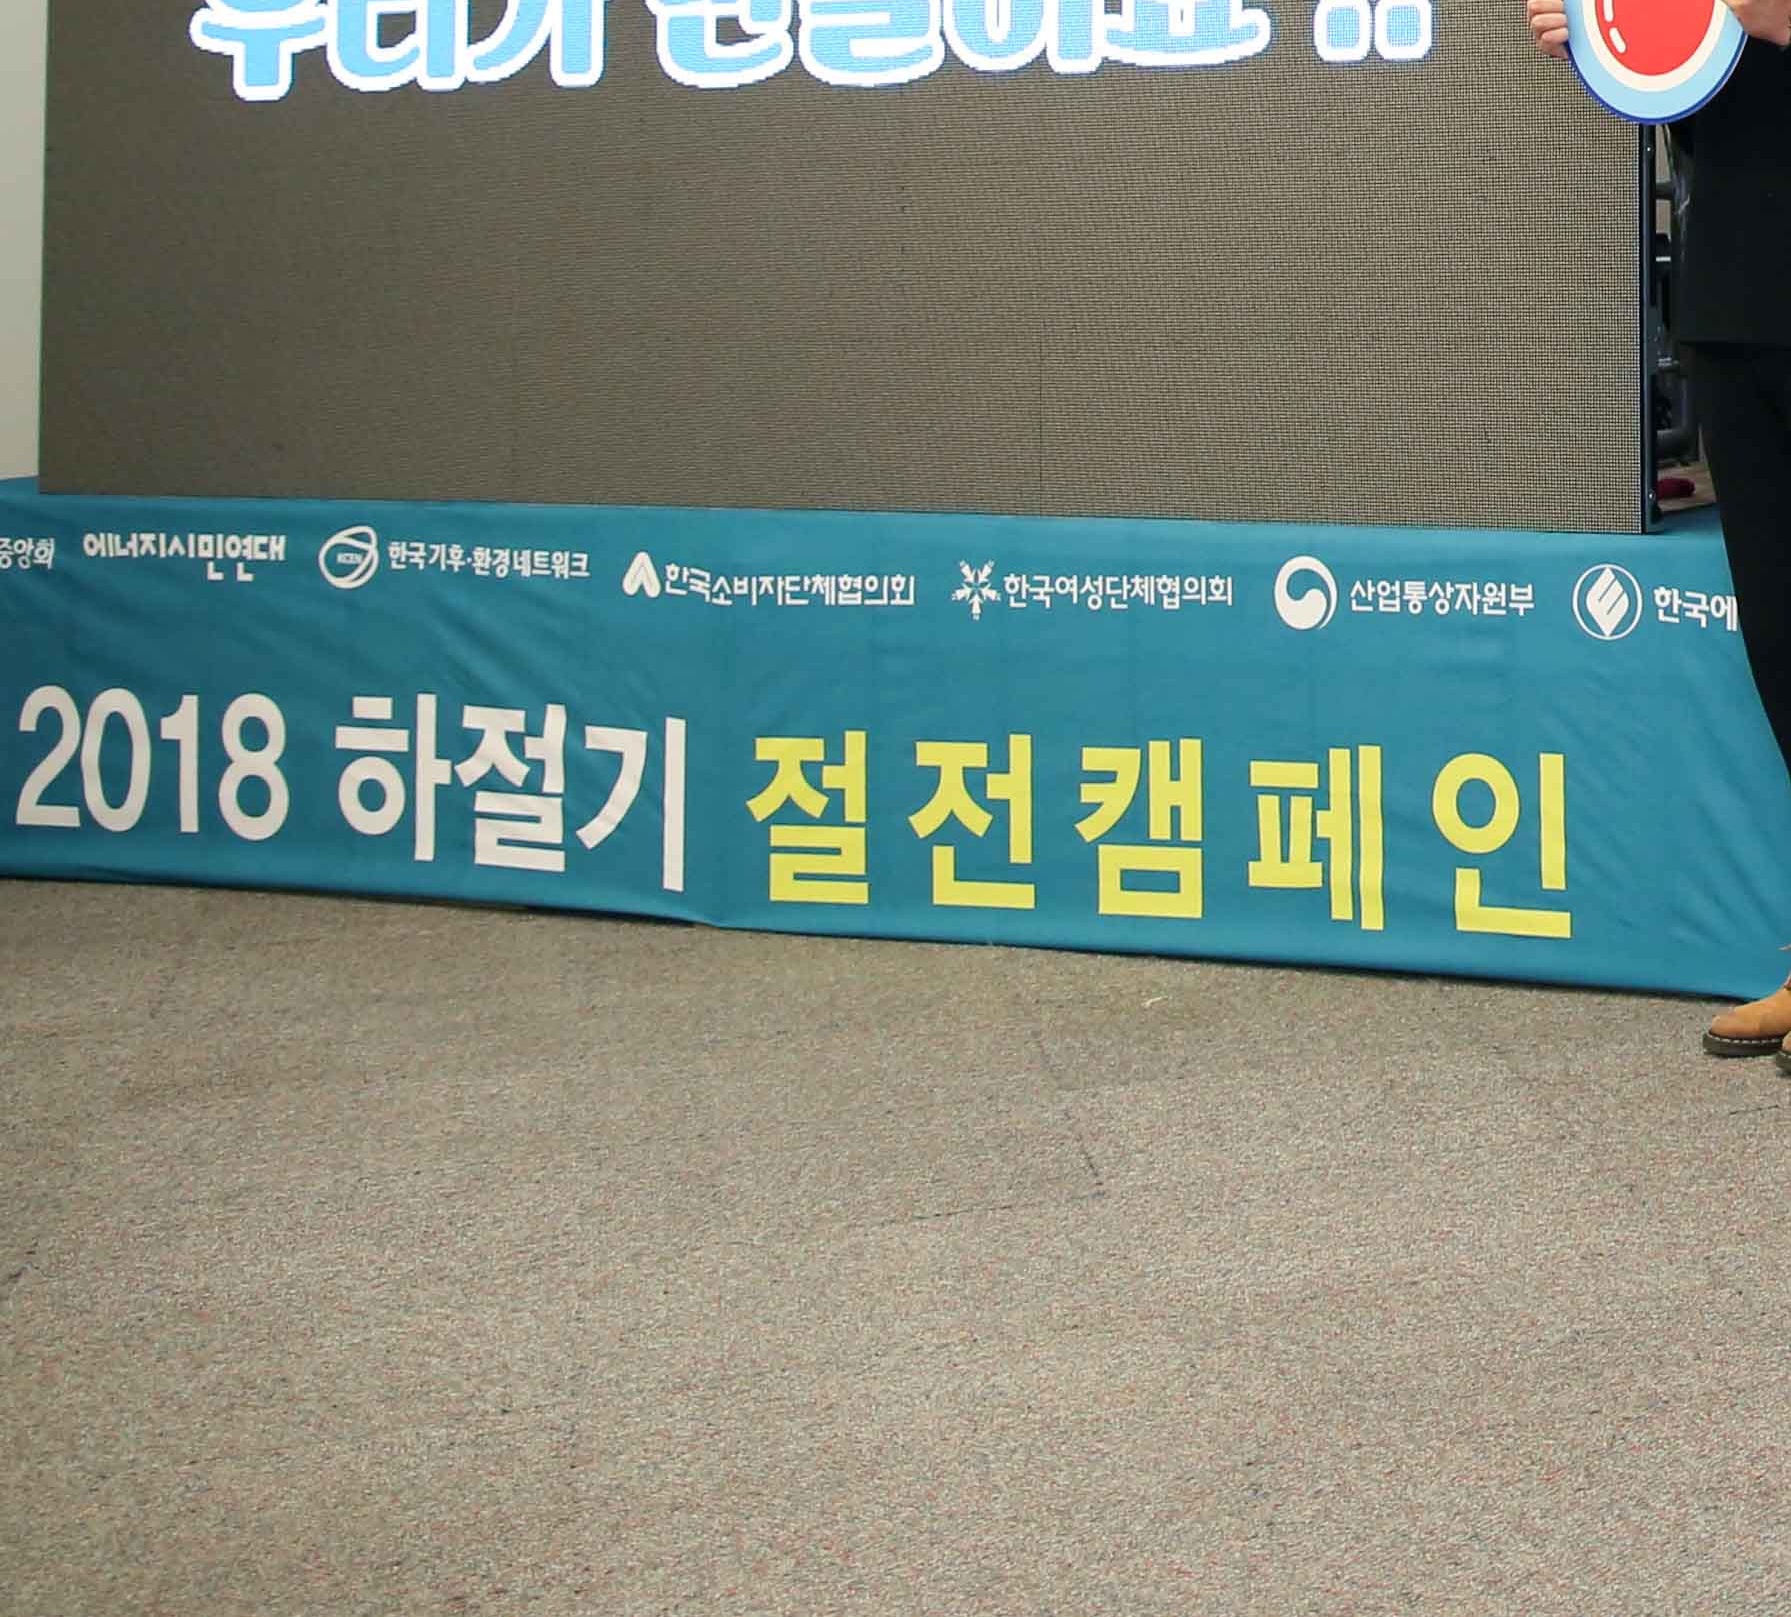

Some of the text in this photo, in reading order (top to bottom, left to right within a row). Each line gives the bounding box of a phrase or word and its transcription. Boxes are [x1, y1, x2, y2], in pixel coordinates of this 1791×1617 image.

[83, 533, 286, 581] 에너지시민연대
[666, 564, 914, 605] 한국소비자단체협의회
[1004, 574, 1232, 610] 한국여성단체협의회
[1351, 580, 1534, 616] 산업통상자원부
[17, 686, 1570, 938] 2018 하절기 절전캠페인
